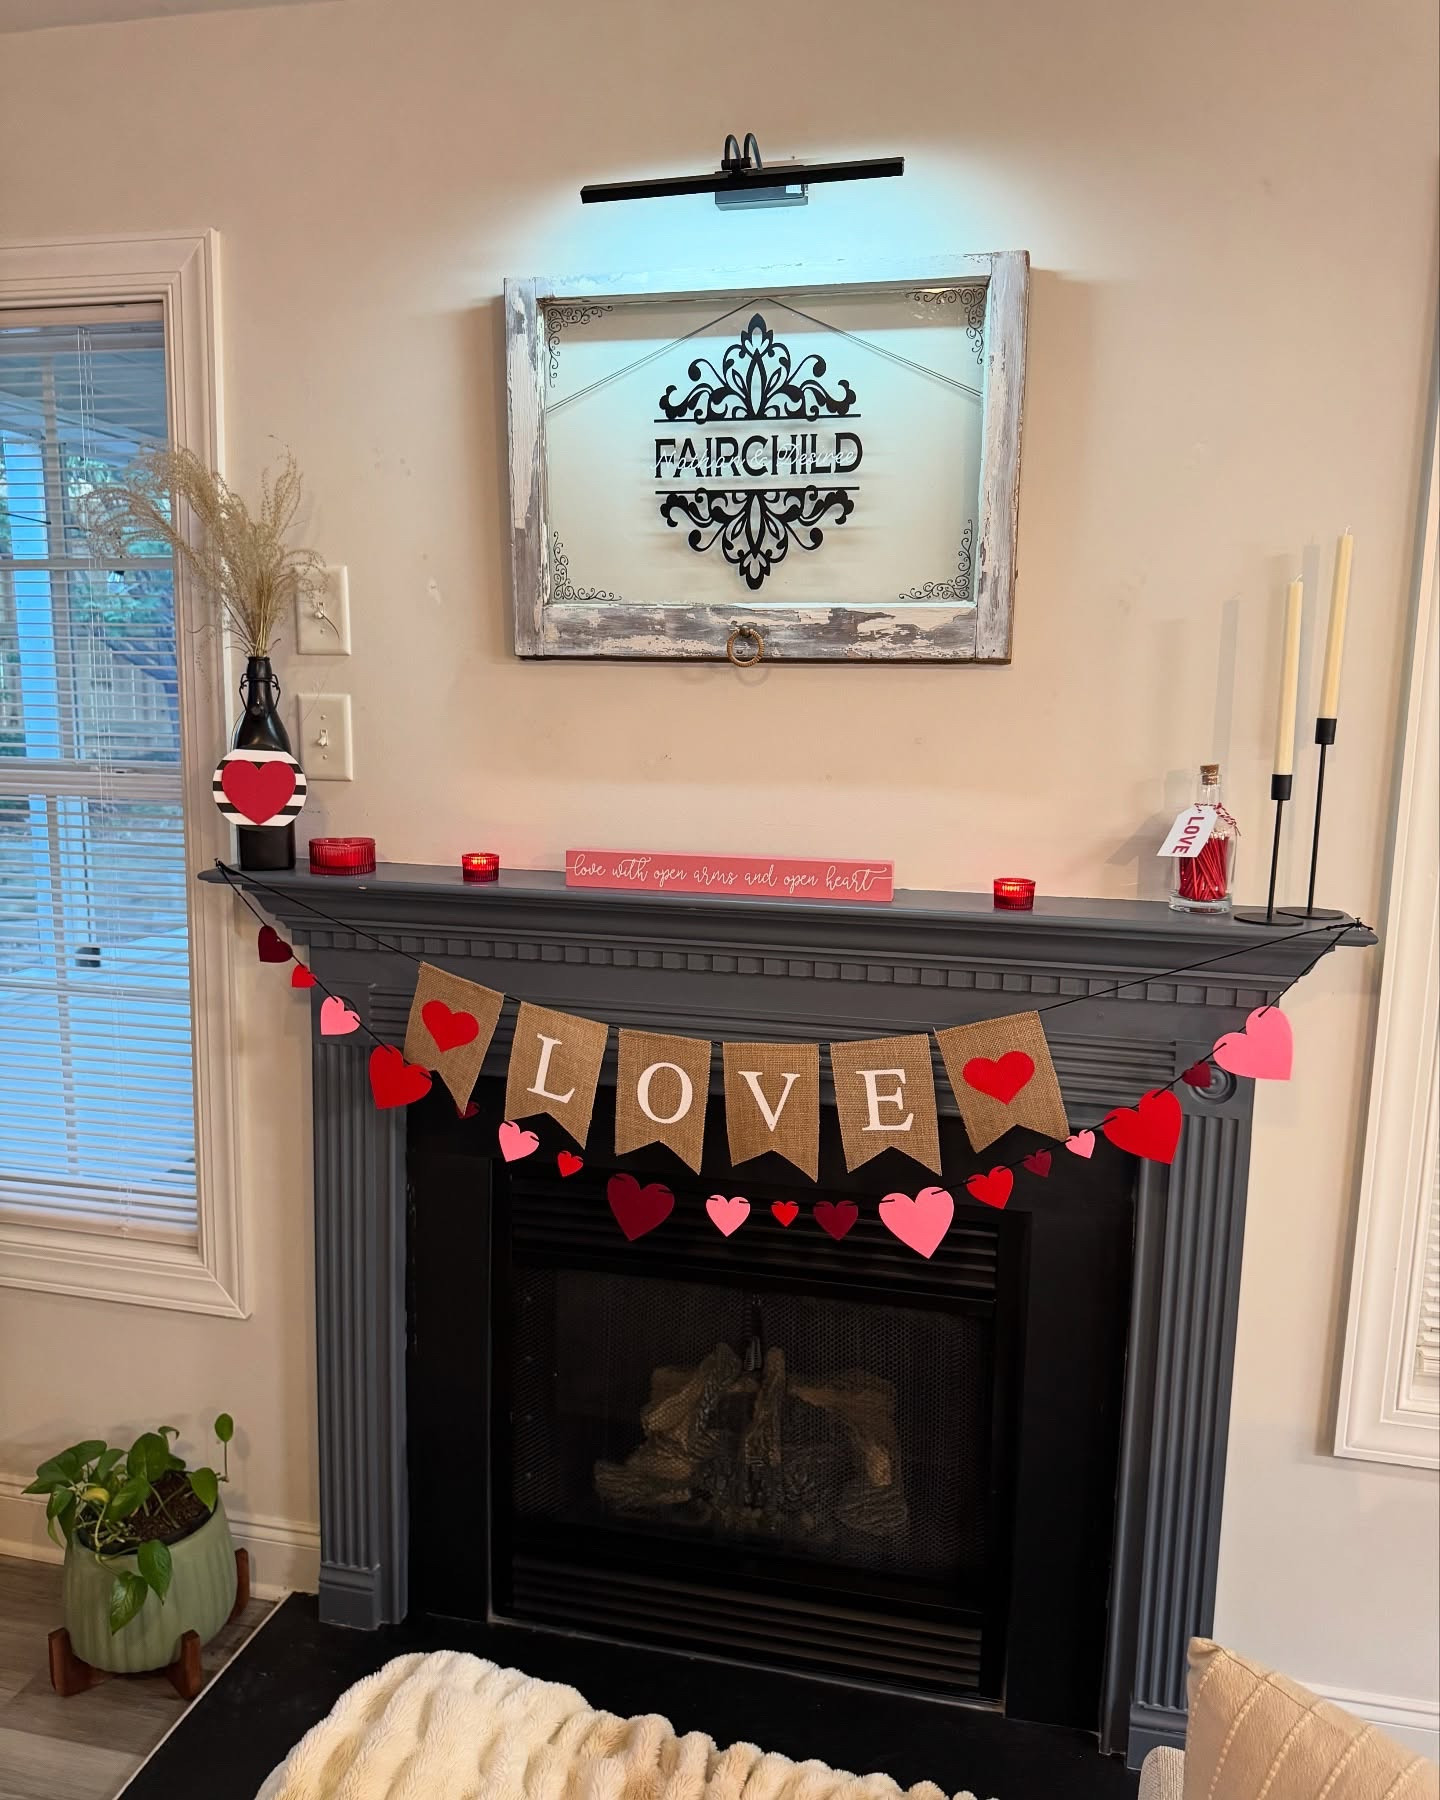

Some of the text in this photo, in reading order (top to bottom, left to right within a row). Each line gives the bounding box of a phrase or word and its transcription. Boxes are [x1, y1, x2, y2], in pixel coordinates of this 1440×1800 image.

[650, 443, 858, 470] Nathan & Desiree
[655, 432, 863, 478] FAIRCHILD
[1172, 816, 1205, 854] LOVE
[567, 853, 890, 894] love with open arms and open heart
